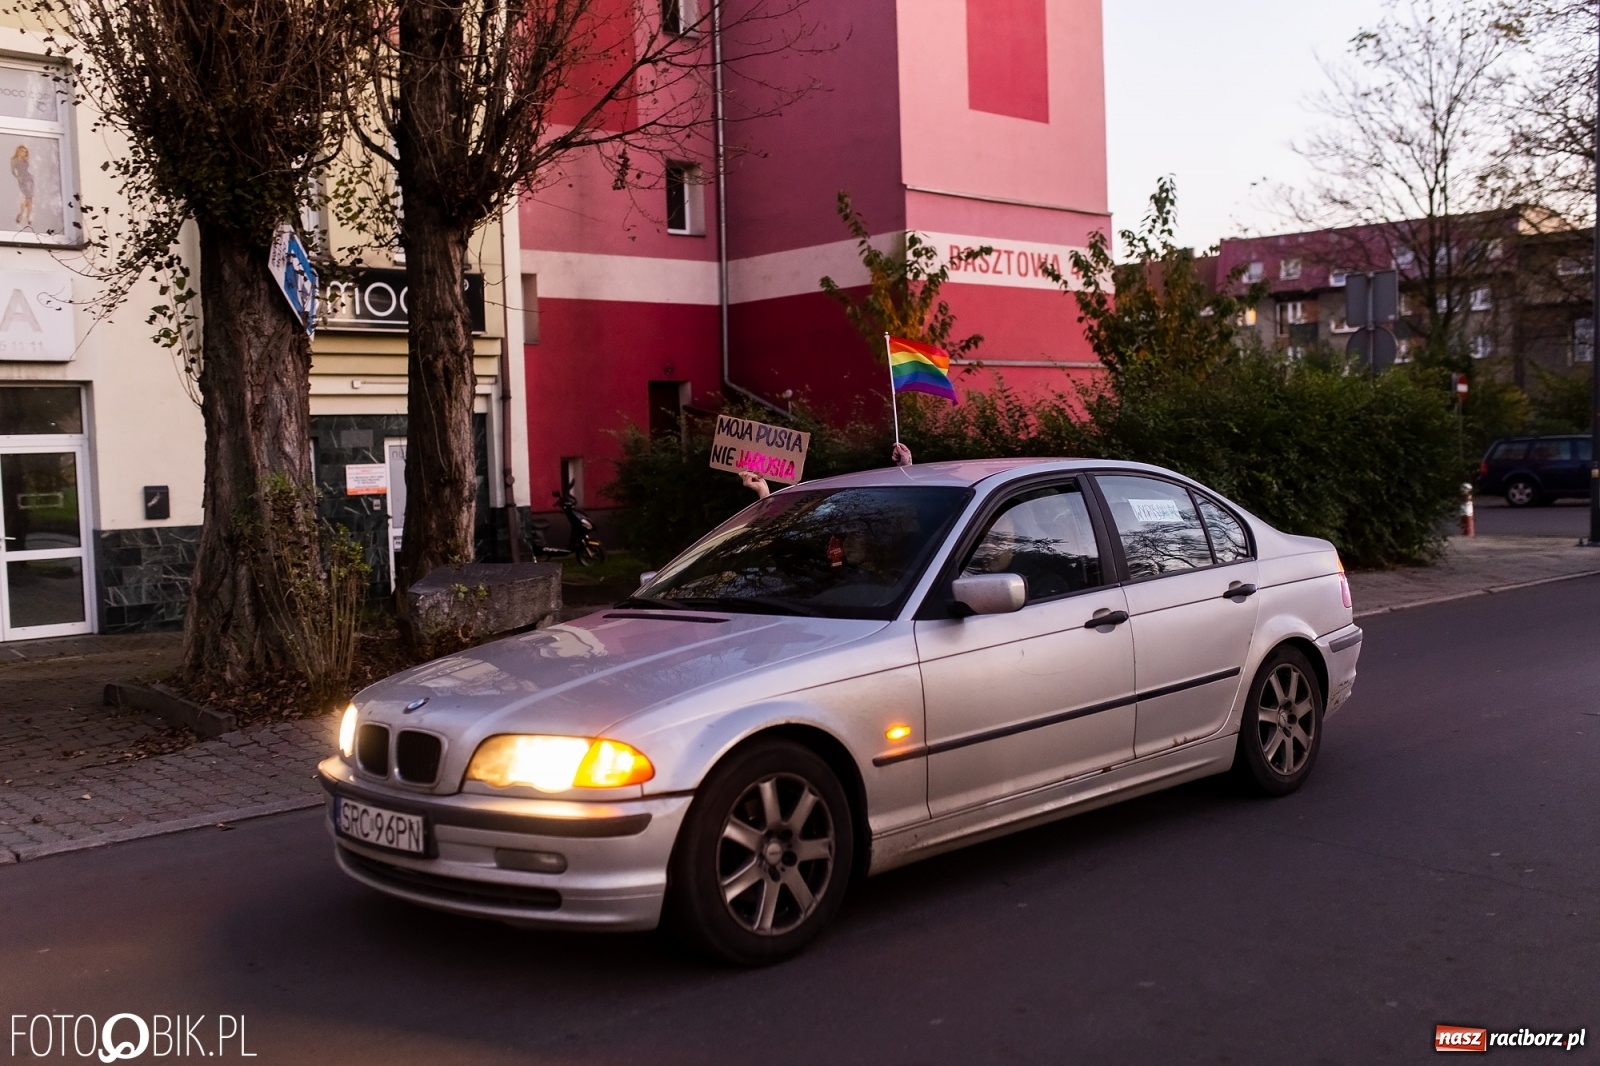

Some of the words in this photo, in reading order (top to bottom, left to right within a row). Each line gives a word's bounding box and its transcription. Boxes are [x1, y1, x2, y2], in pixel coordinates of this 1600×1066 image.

[949, 244, 1062, 279] BASZTOWA
[717, 417, 753, 442] MOJA
[756, 425, 803, 453] PUSIA
[711, 444, 737, 466] NIE
